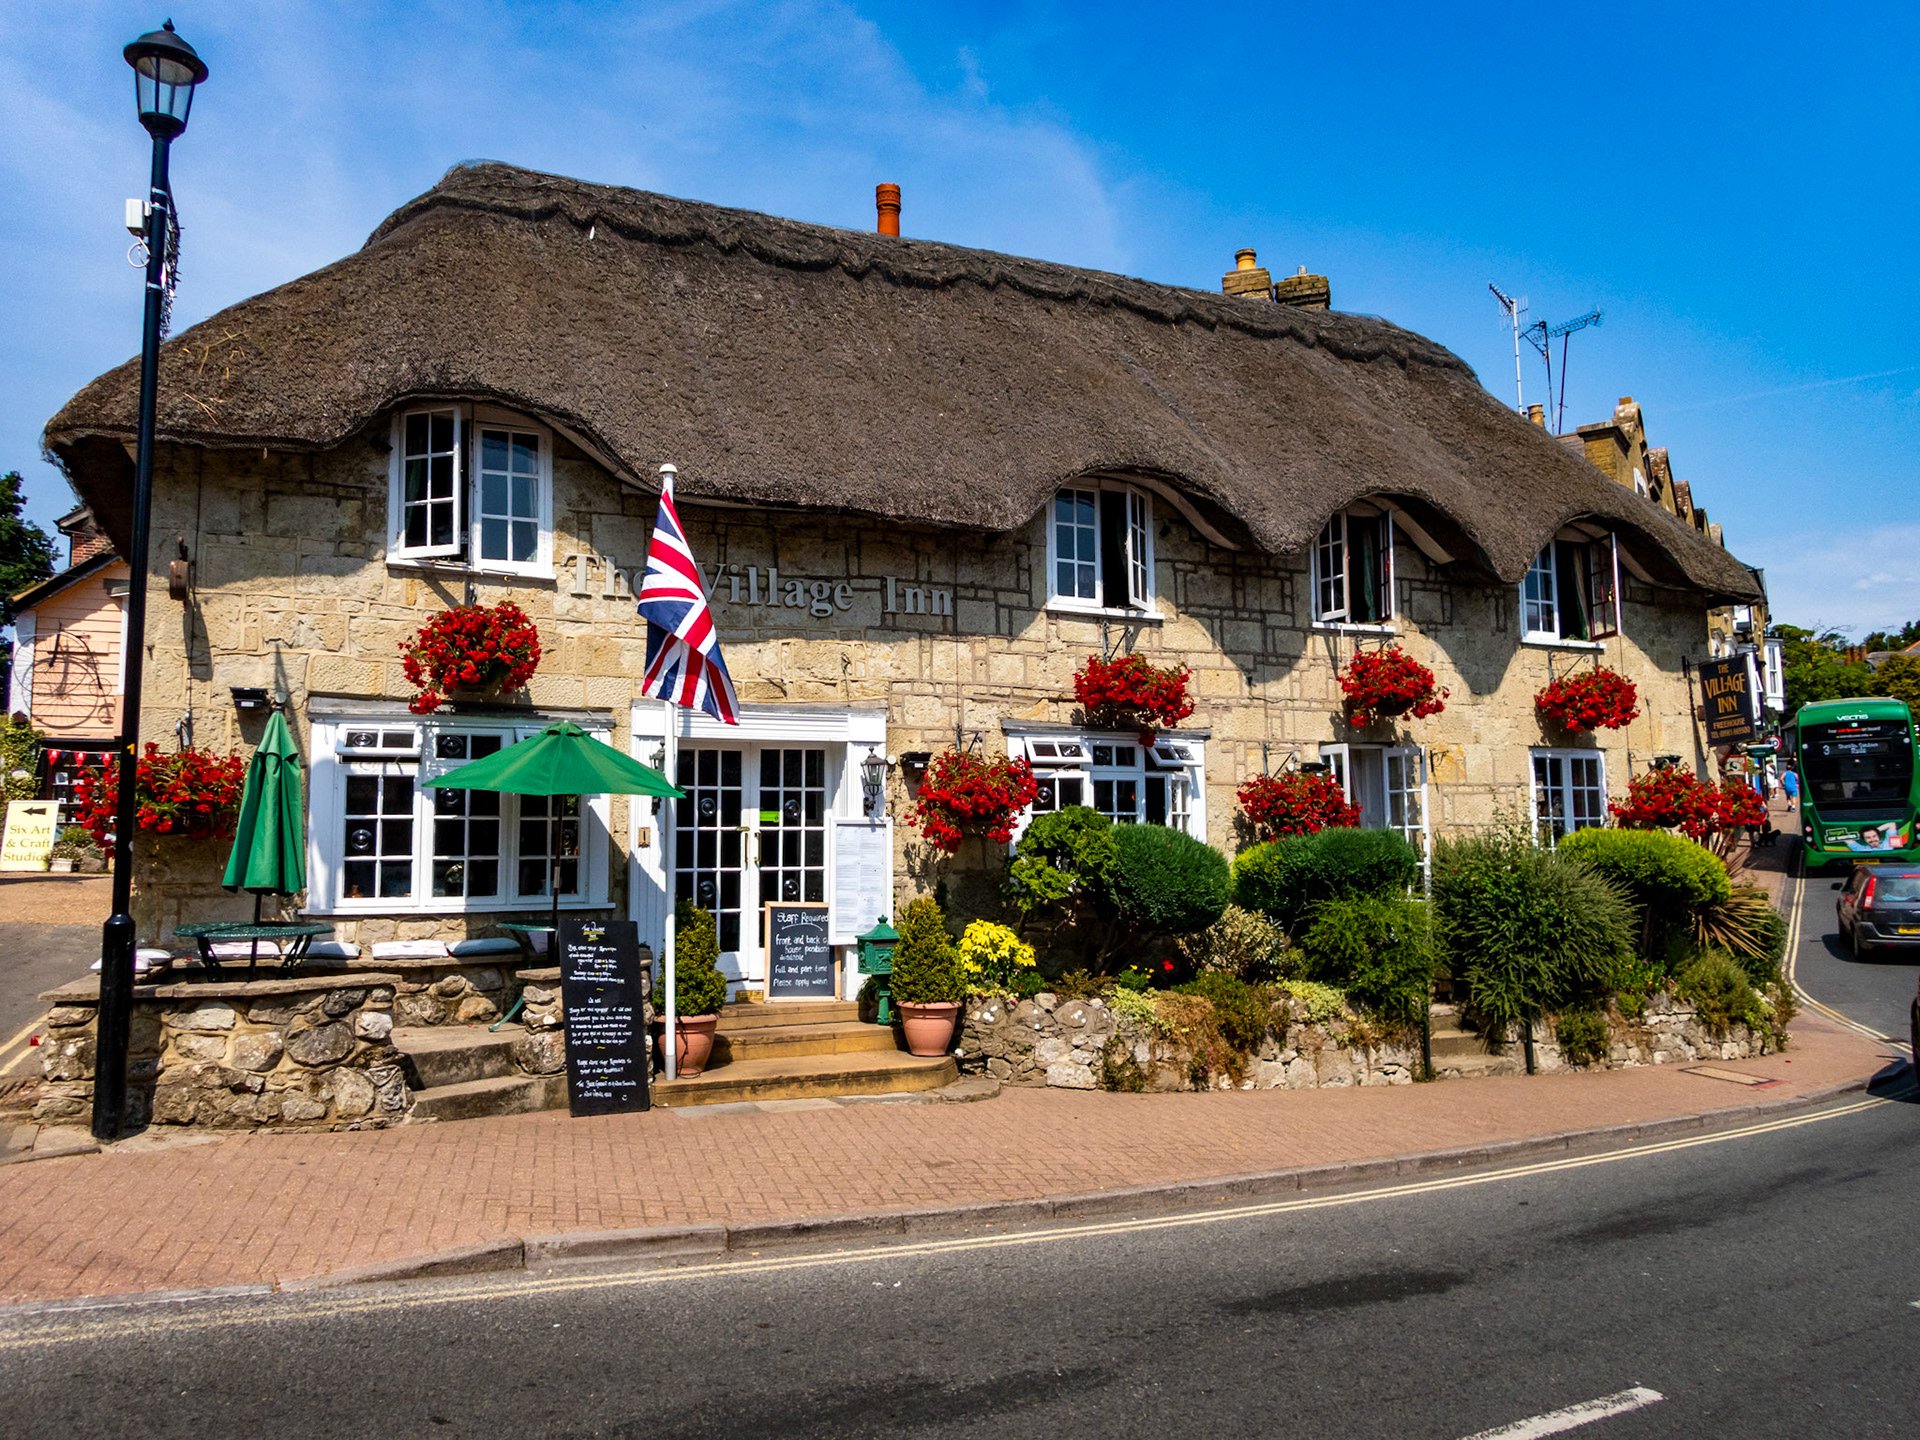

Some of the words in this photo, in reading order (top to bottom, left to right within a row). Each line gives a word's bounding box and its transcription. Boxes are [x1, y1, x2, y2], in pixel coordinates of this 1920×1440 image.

[698, 562, 854, 618] Village
[883, 575, 954, 616] Inn
[1717, 663, 1730, 674] THE
[1704, 672, 1747, 700] VILLAGE
[1717, 695, 1738, 714] INN
[126, 743, 136, 756] 1
[1822, 744, 1830, 755] 3
[9, 825, 27, 835] Six
[31, 825, 51, 835] Art
[6, 838, 16, 848] &
[20, 838, 51, 848] Craft
[3, 851, 48, 862] Studio
[777, 911, 799, 924] Staff
[801, 911, 829, 924] Required
[794, 935, 805, 945] and
[806, 935, 820, 944] back
[788, 965, 799, 974] and
[801, 966, 813, 974] part
[773, 978, 792, 987] Please
[795, 978, 809, 987] apply
